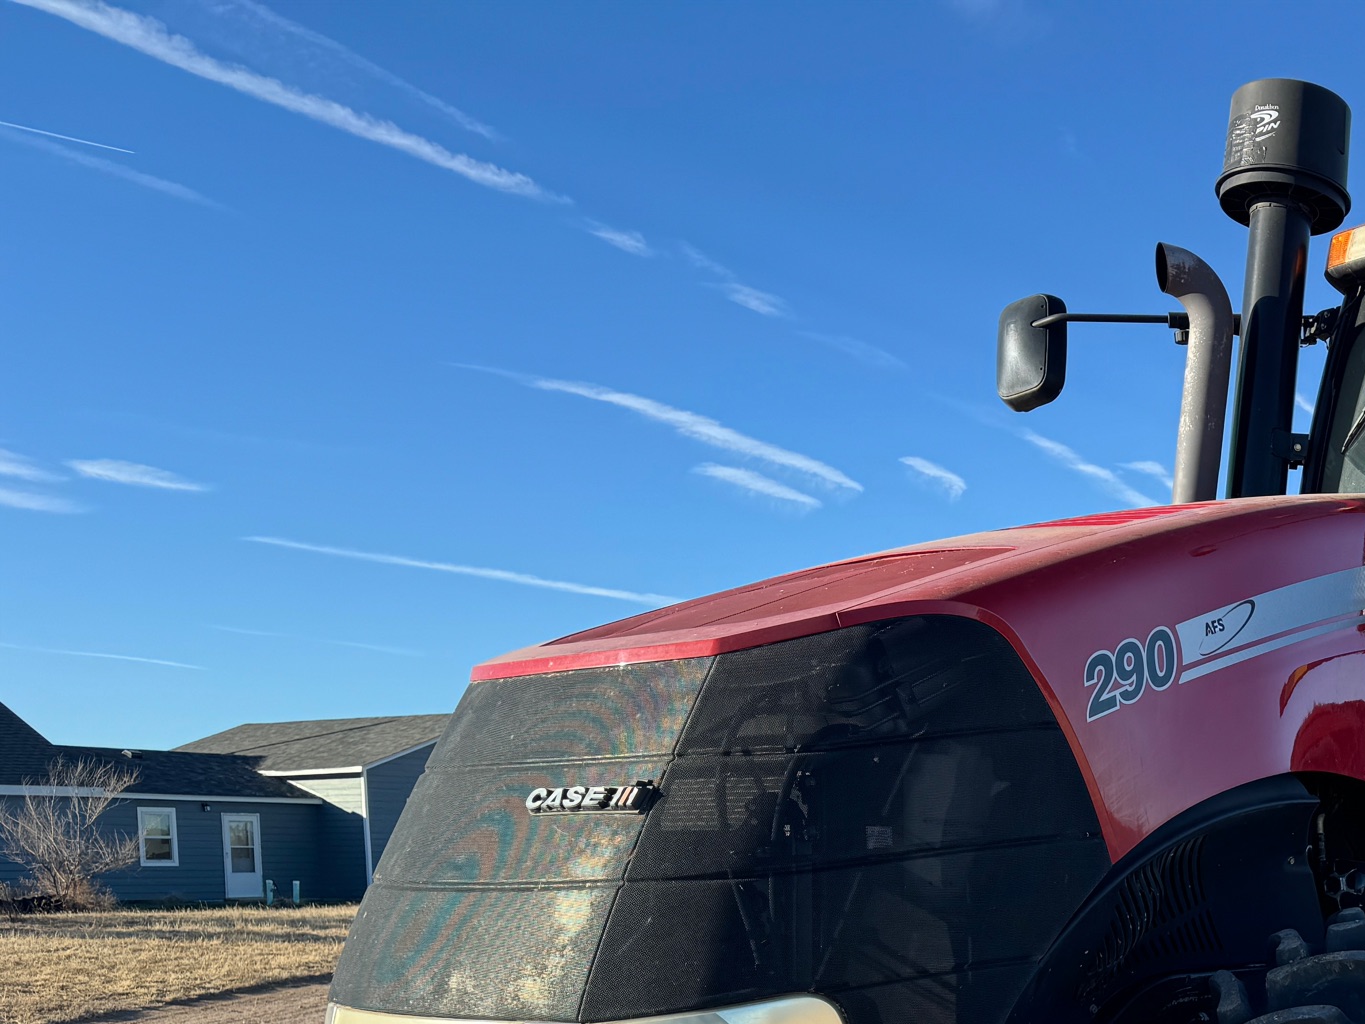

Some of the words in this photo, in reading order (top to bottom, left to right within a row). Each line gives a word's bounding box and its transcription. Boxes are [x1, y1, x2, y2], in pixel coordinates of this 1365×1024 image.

[1205, 618, 1225, 637] AFS
[1084, 625, 1178, 723] 290
[525, 786, 607, 811] CASE
